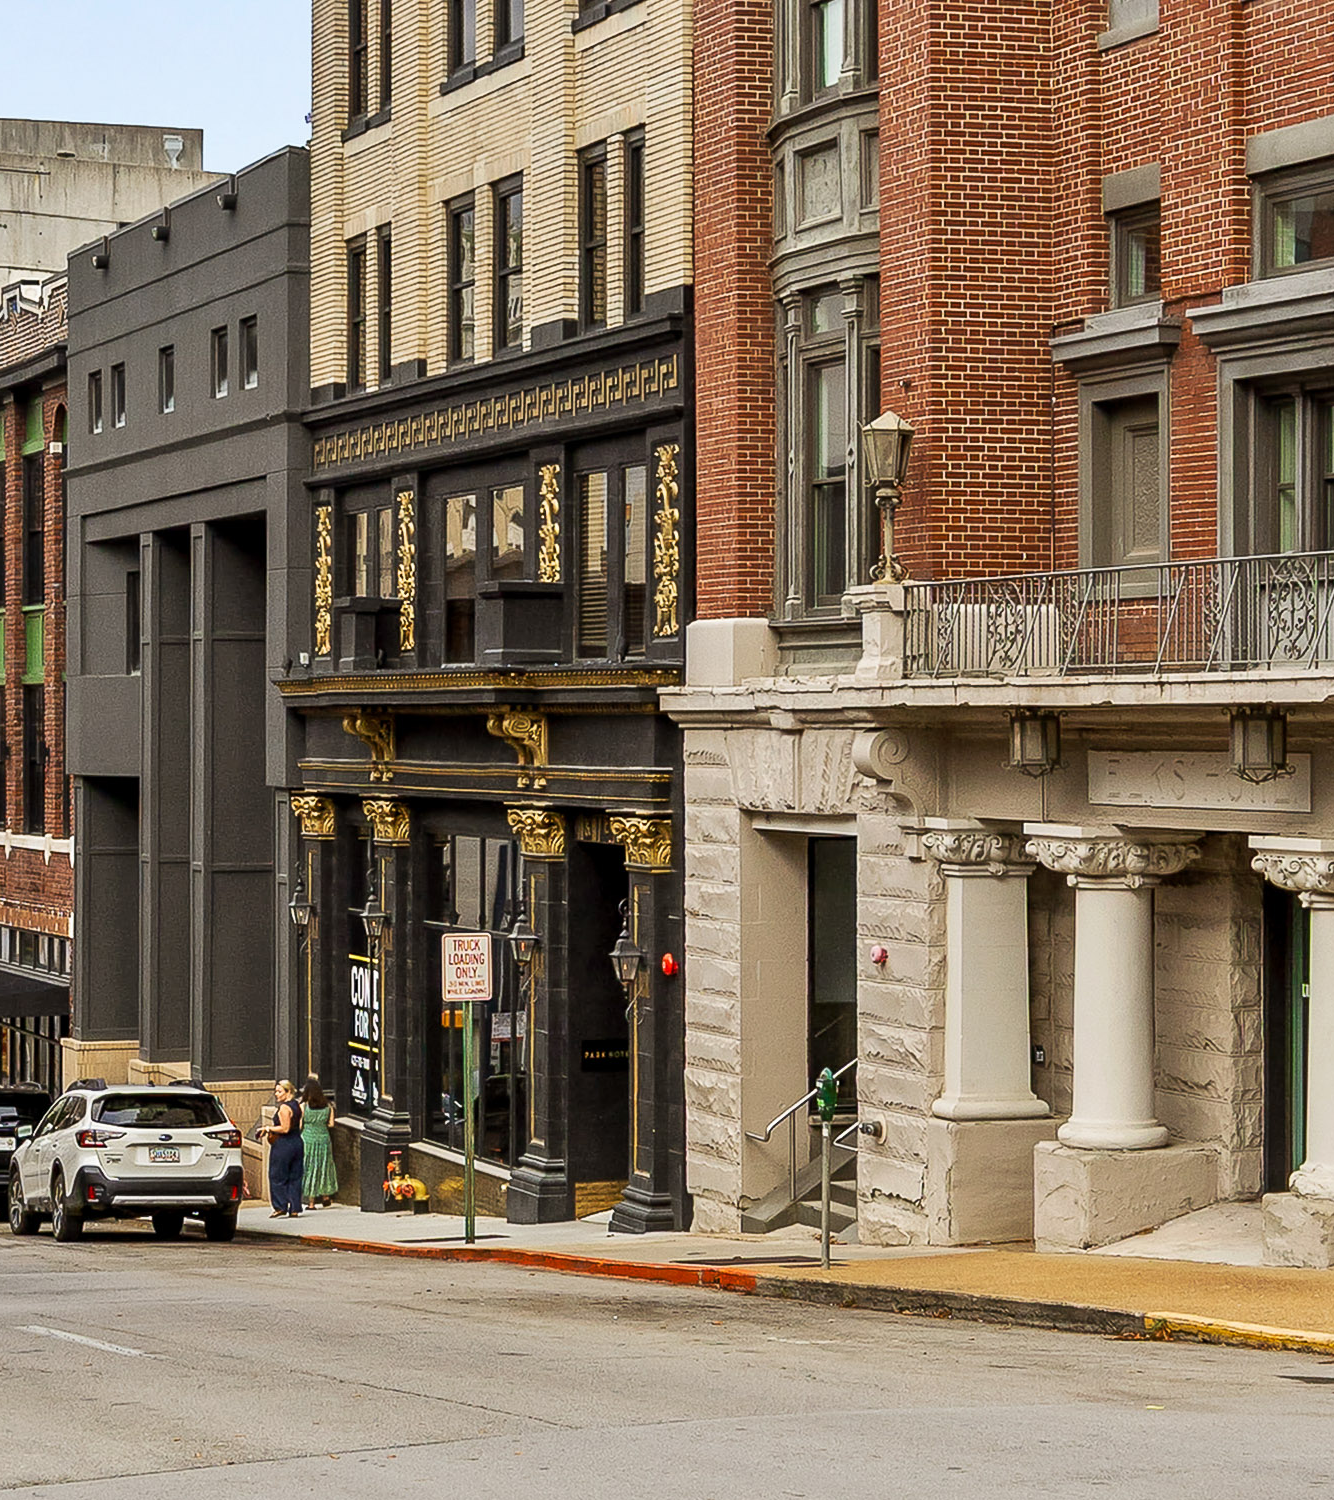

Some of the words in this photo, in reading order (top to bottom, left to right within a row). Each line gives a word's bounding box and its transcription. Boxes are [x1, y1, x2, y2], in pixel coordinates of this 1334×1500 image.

[453, 939, 481, 951] TRUCK
[448, 953, 485, 965] LOADING
[455, 967, 478, 979] ONLY
[354, 1008, 369, 1039] FOR
